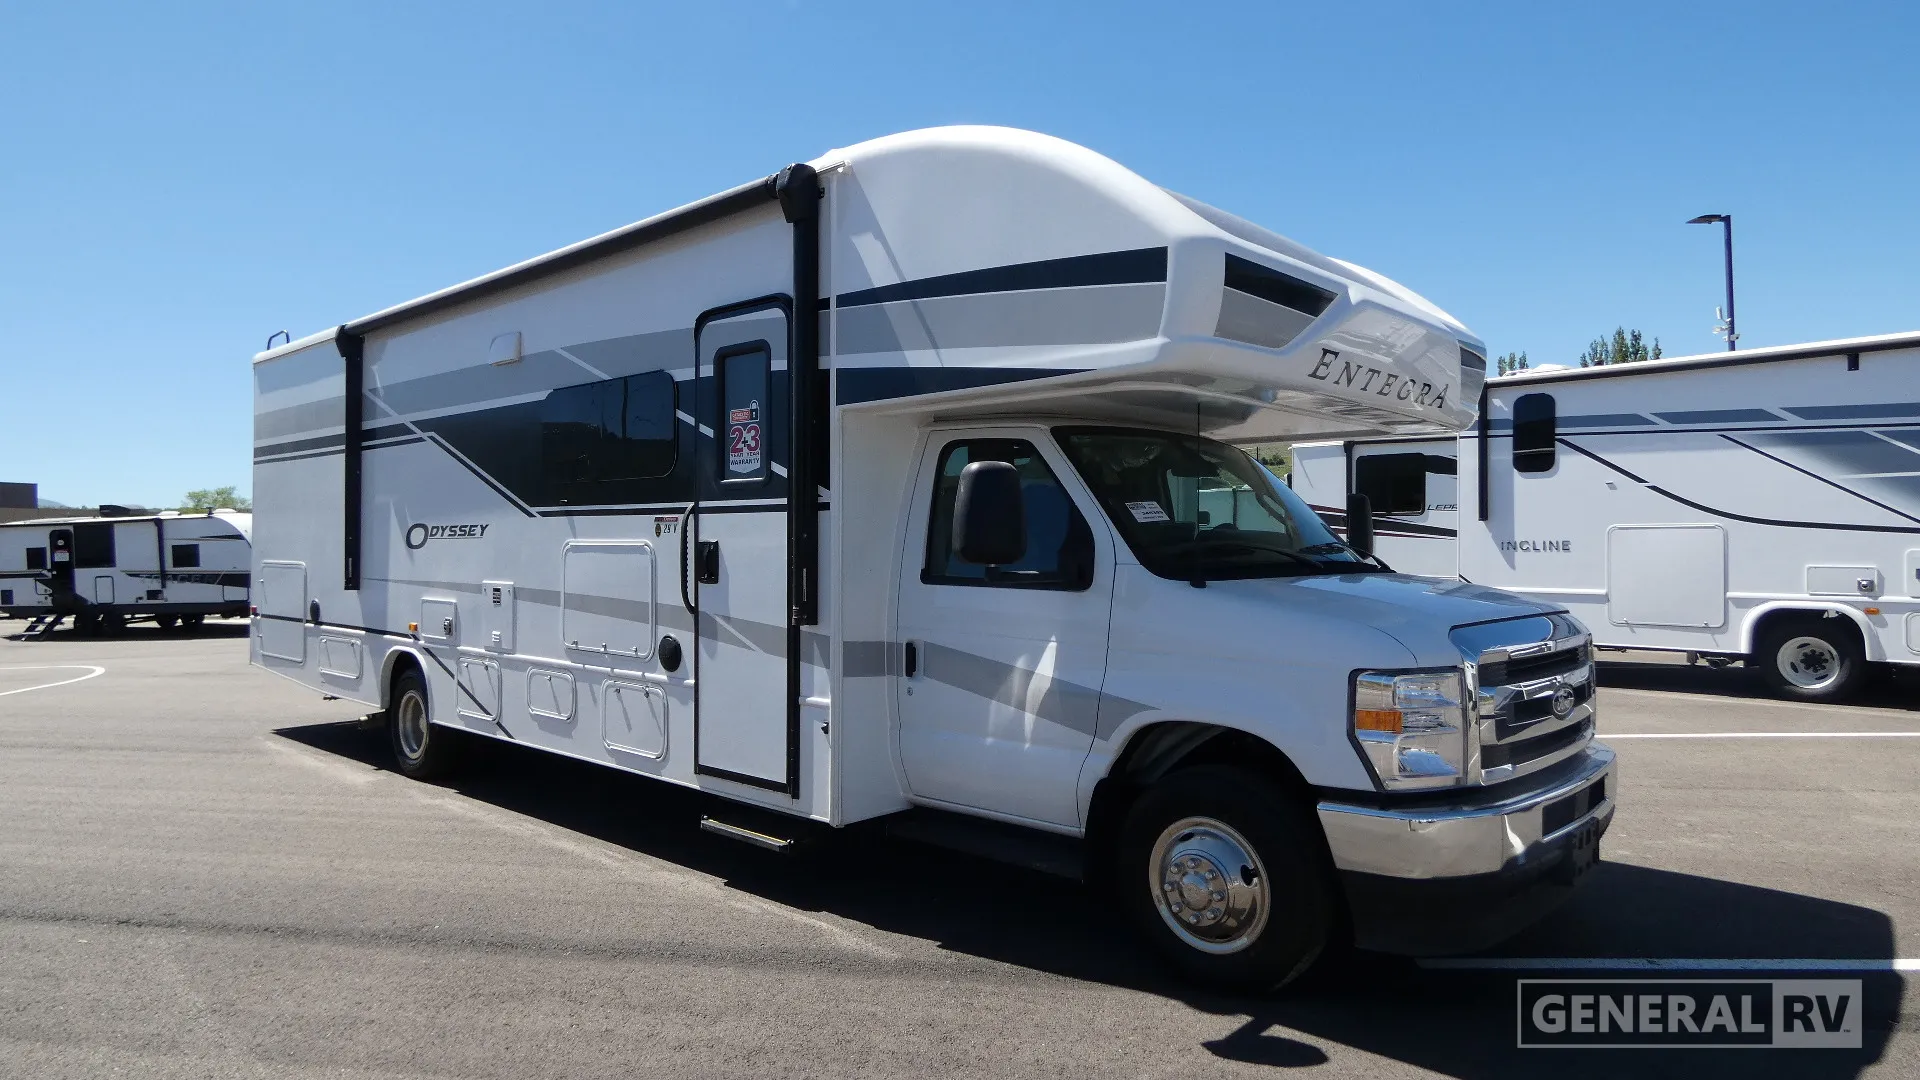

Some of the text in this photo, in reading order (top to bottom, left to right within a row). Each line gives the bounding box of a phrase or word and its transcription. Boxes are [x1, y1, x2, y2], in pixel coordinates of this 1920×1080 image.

[1307, 347, 1449, 409] ENTEGRA
[730, 458, 760, 466] WARRANTY
[405, 523, 490, 550] ODYSSEY
[1501, 540, 1572, 552] INCLINE
